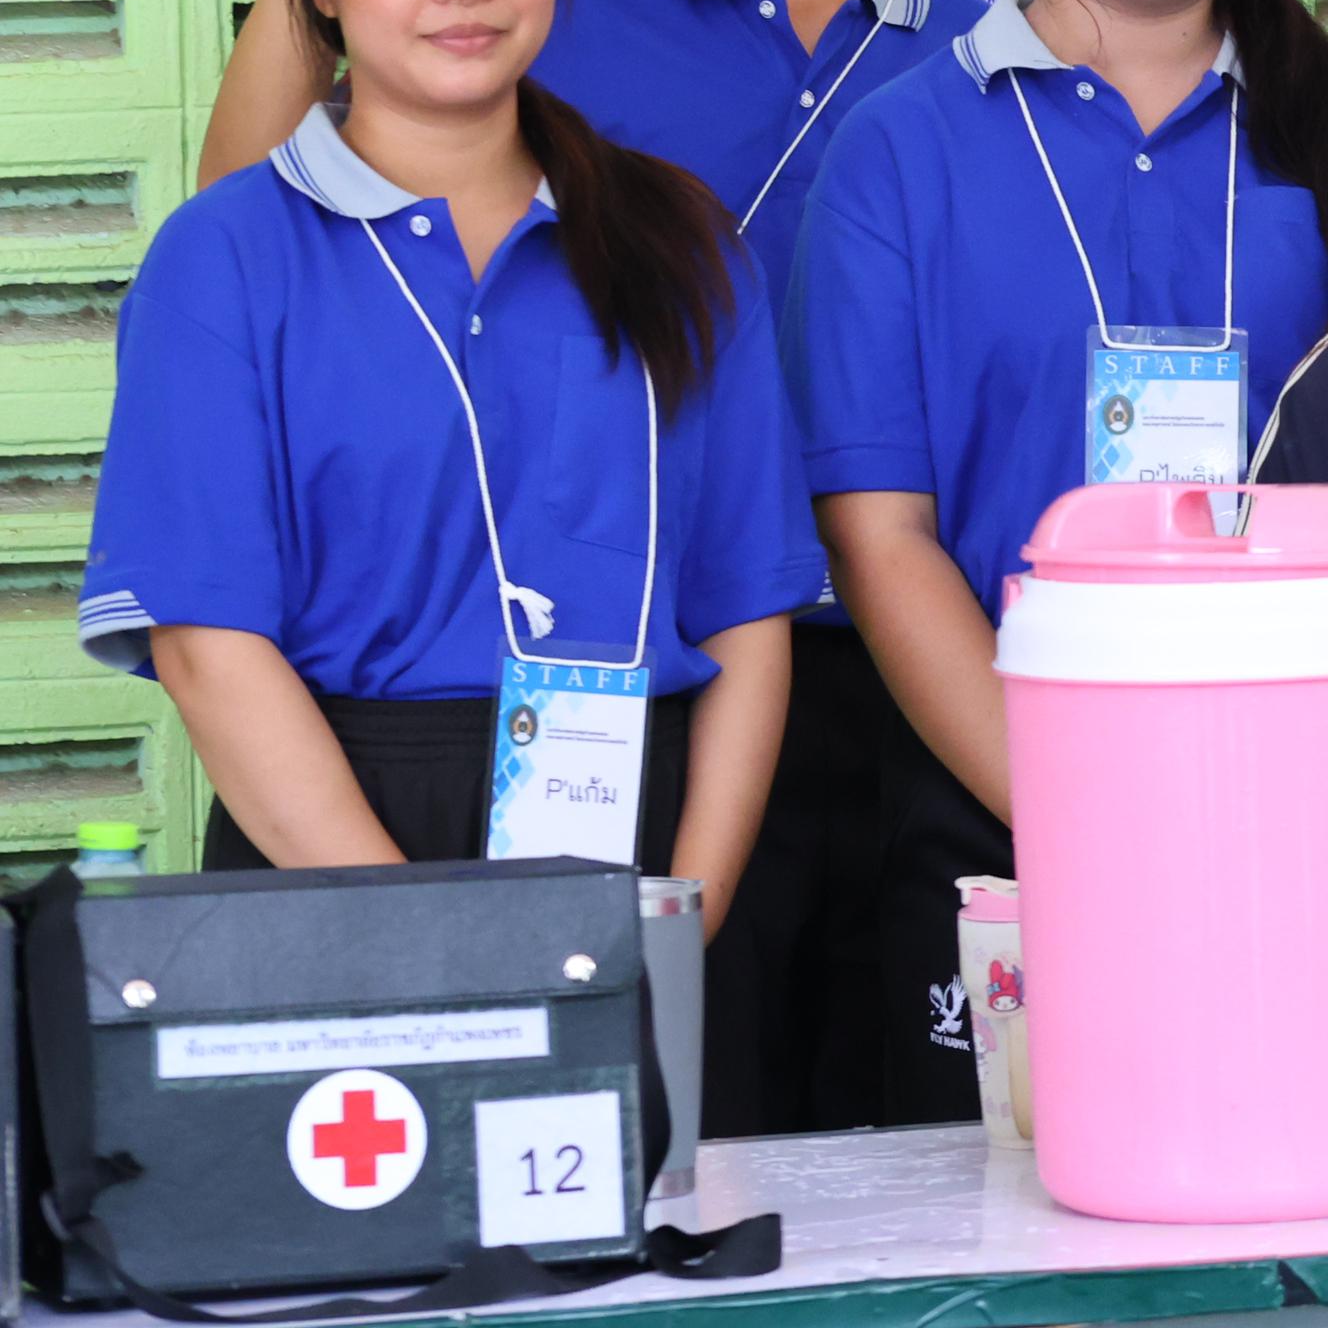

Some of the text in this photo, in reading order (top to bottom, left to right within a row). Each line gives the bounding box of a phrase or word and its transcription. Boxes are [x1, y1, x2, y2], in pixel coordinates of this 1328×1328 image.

[1104, 355, 1230, 376] STAFF
[512, 662, 639, 691] STAFF
[519, 1144, 587, 1198] 12
